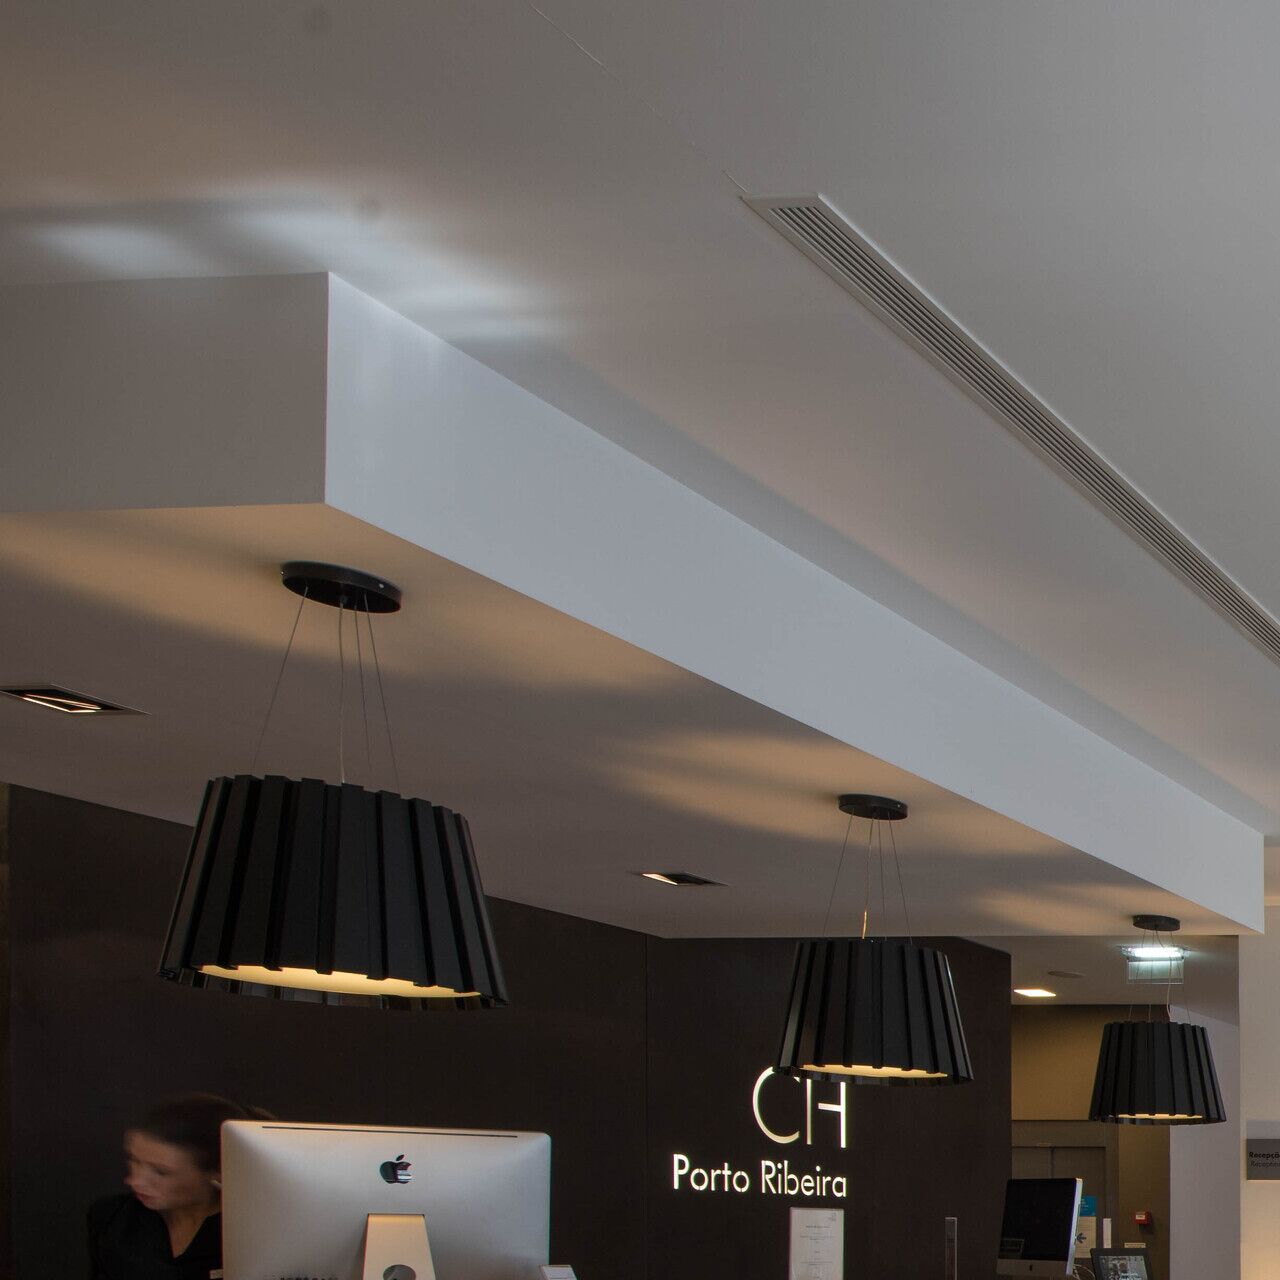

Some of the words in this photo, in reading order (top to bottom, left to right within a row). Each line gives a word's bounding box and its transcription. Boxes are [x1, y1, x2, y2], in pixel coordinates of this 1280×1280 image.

[752, 1066, 847, 1148] CH
[672, 1153, 750, 1193] Porto
[761, 1159, 847, 1198] Ribeira
